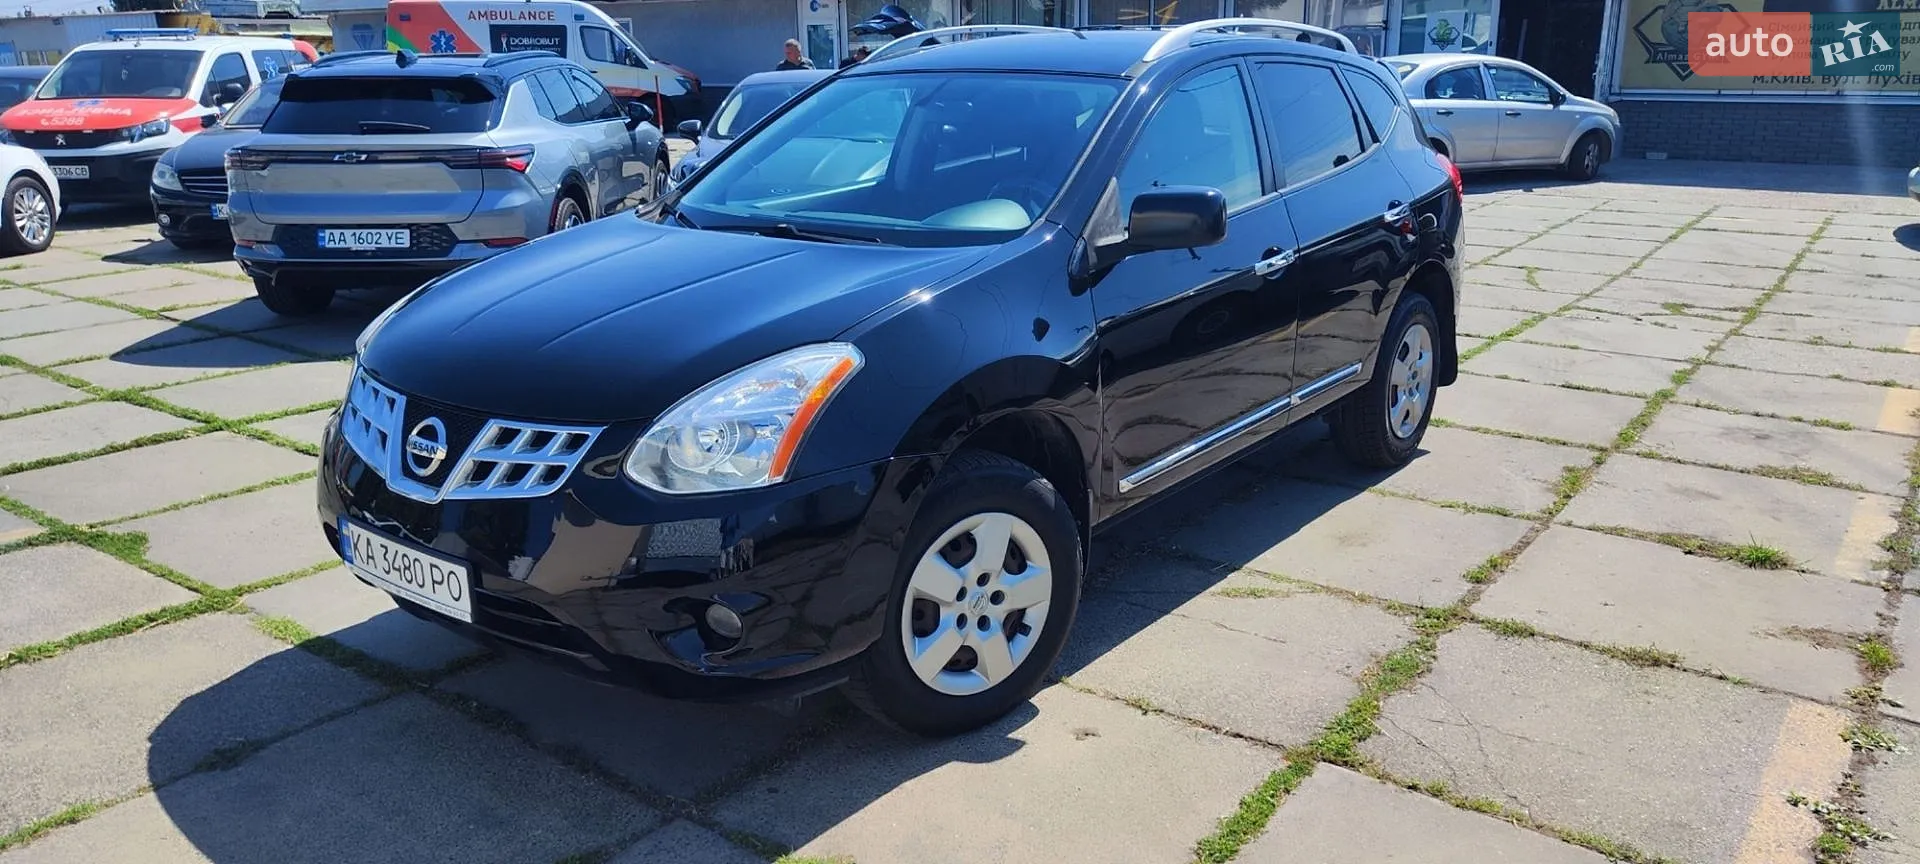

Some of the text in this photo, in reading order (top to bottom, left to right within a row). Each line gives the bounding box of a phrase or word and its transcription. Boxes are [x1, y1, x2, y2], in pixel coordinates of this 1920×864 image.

[468, 10, 556, 21] AMBULANCE
[74, 166, 88, 177] CB
[327, 231, 405, 246] AA 1602 YE
[350, 529, 462, 602] KA 3480 PO
